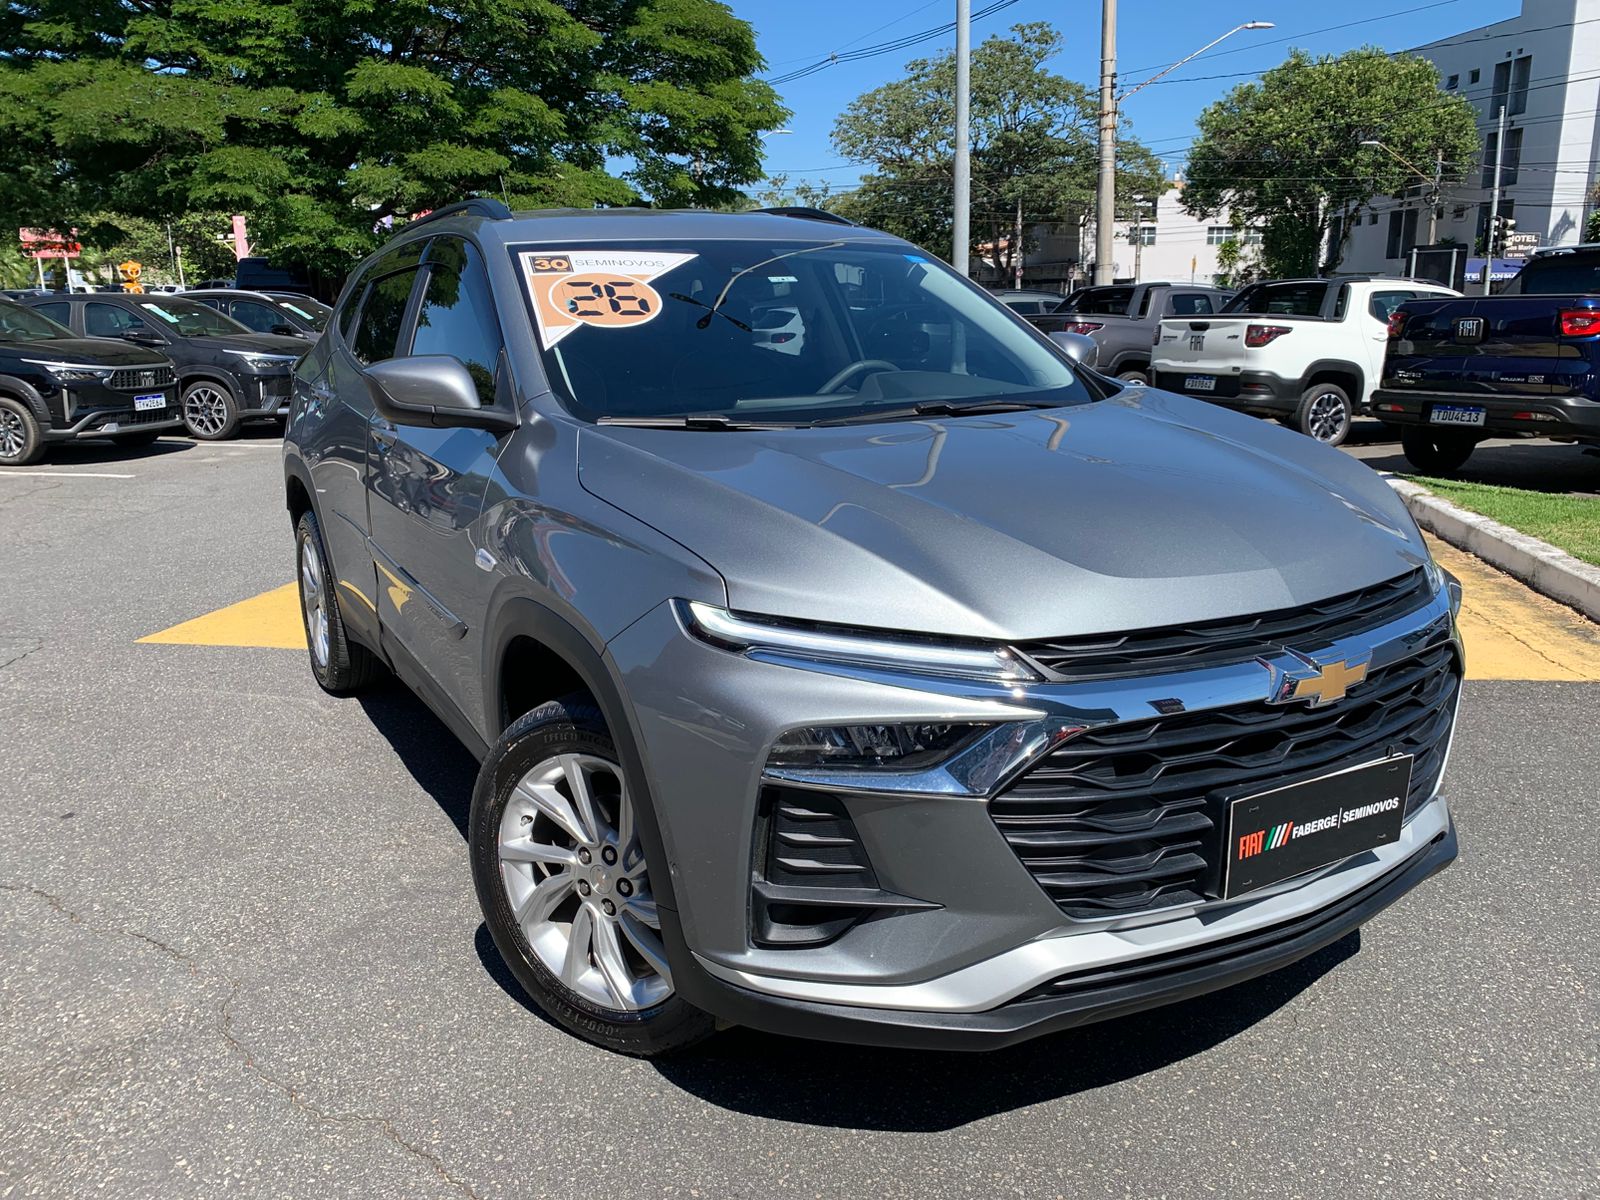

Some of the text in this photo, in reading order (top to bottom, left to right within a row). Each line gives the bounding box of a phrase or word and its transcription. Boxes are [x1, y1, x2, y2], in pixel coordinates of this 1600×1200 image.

[1508, 235, 1538, 243] HOTEL
[534, 259, 665, 270] 30 SEMINOVOS
[566, 281, 651, 316] 26
[1458, 320, 1479, 337] FIAT
[1190, 335, 1205, 351] FIAT
[1436, 410, 1480, 423] TDU4E13
[1238, 797, 1399, 860] FIAT FABERGE SEMINOVOS
